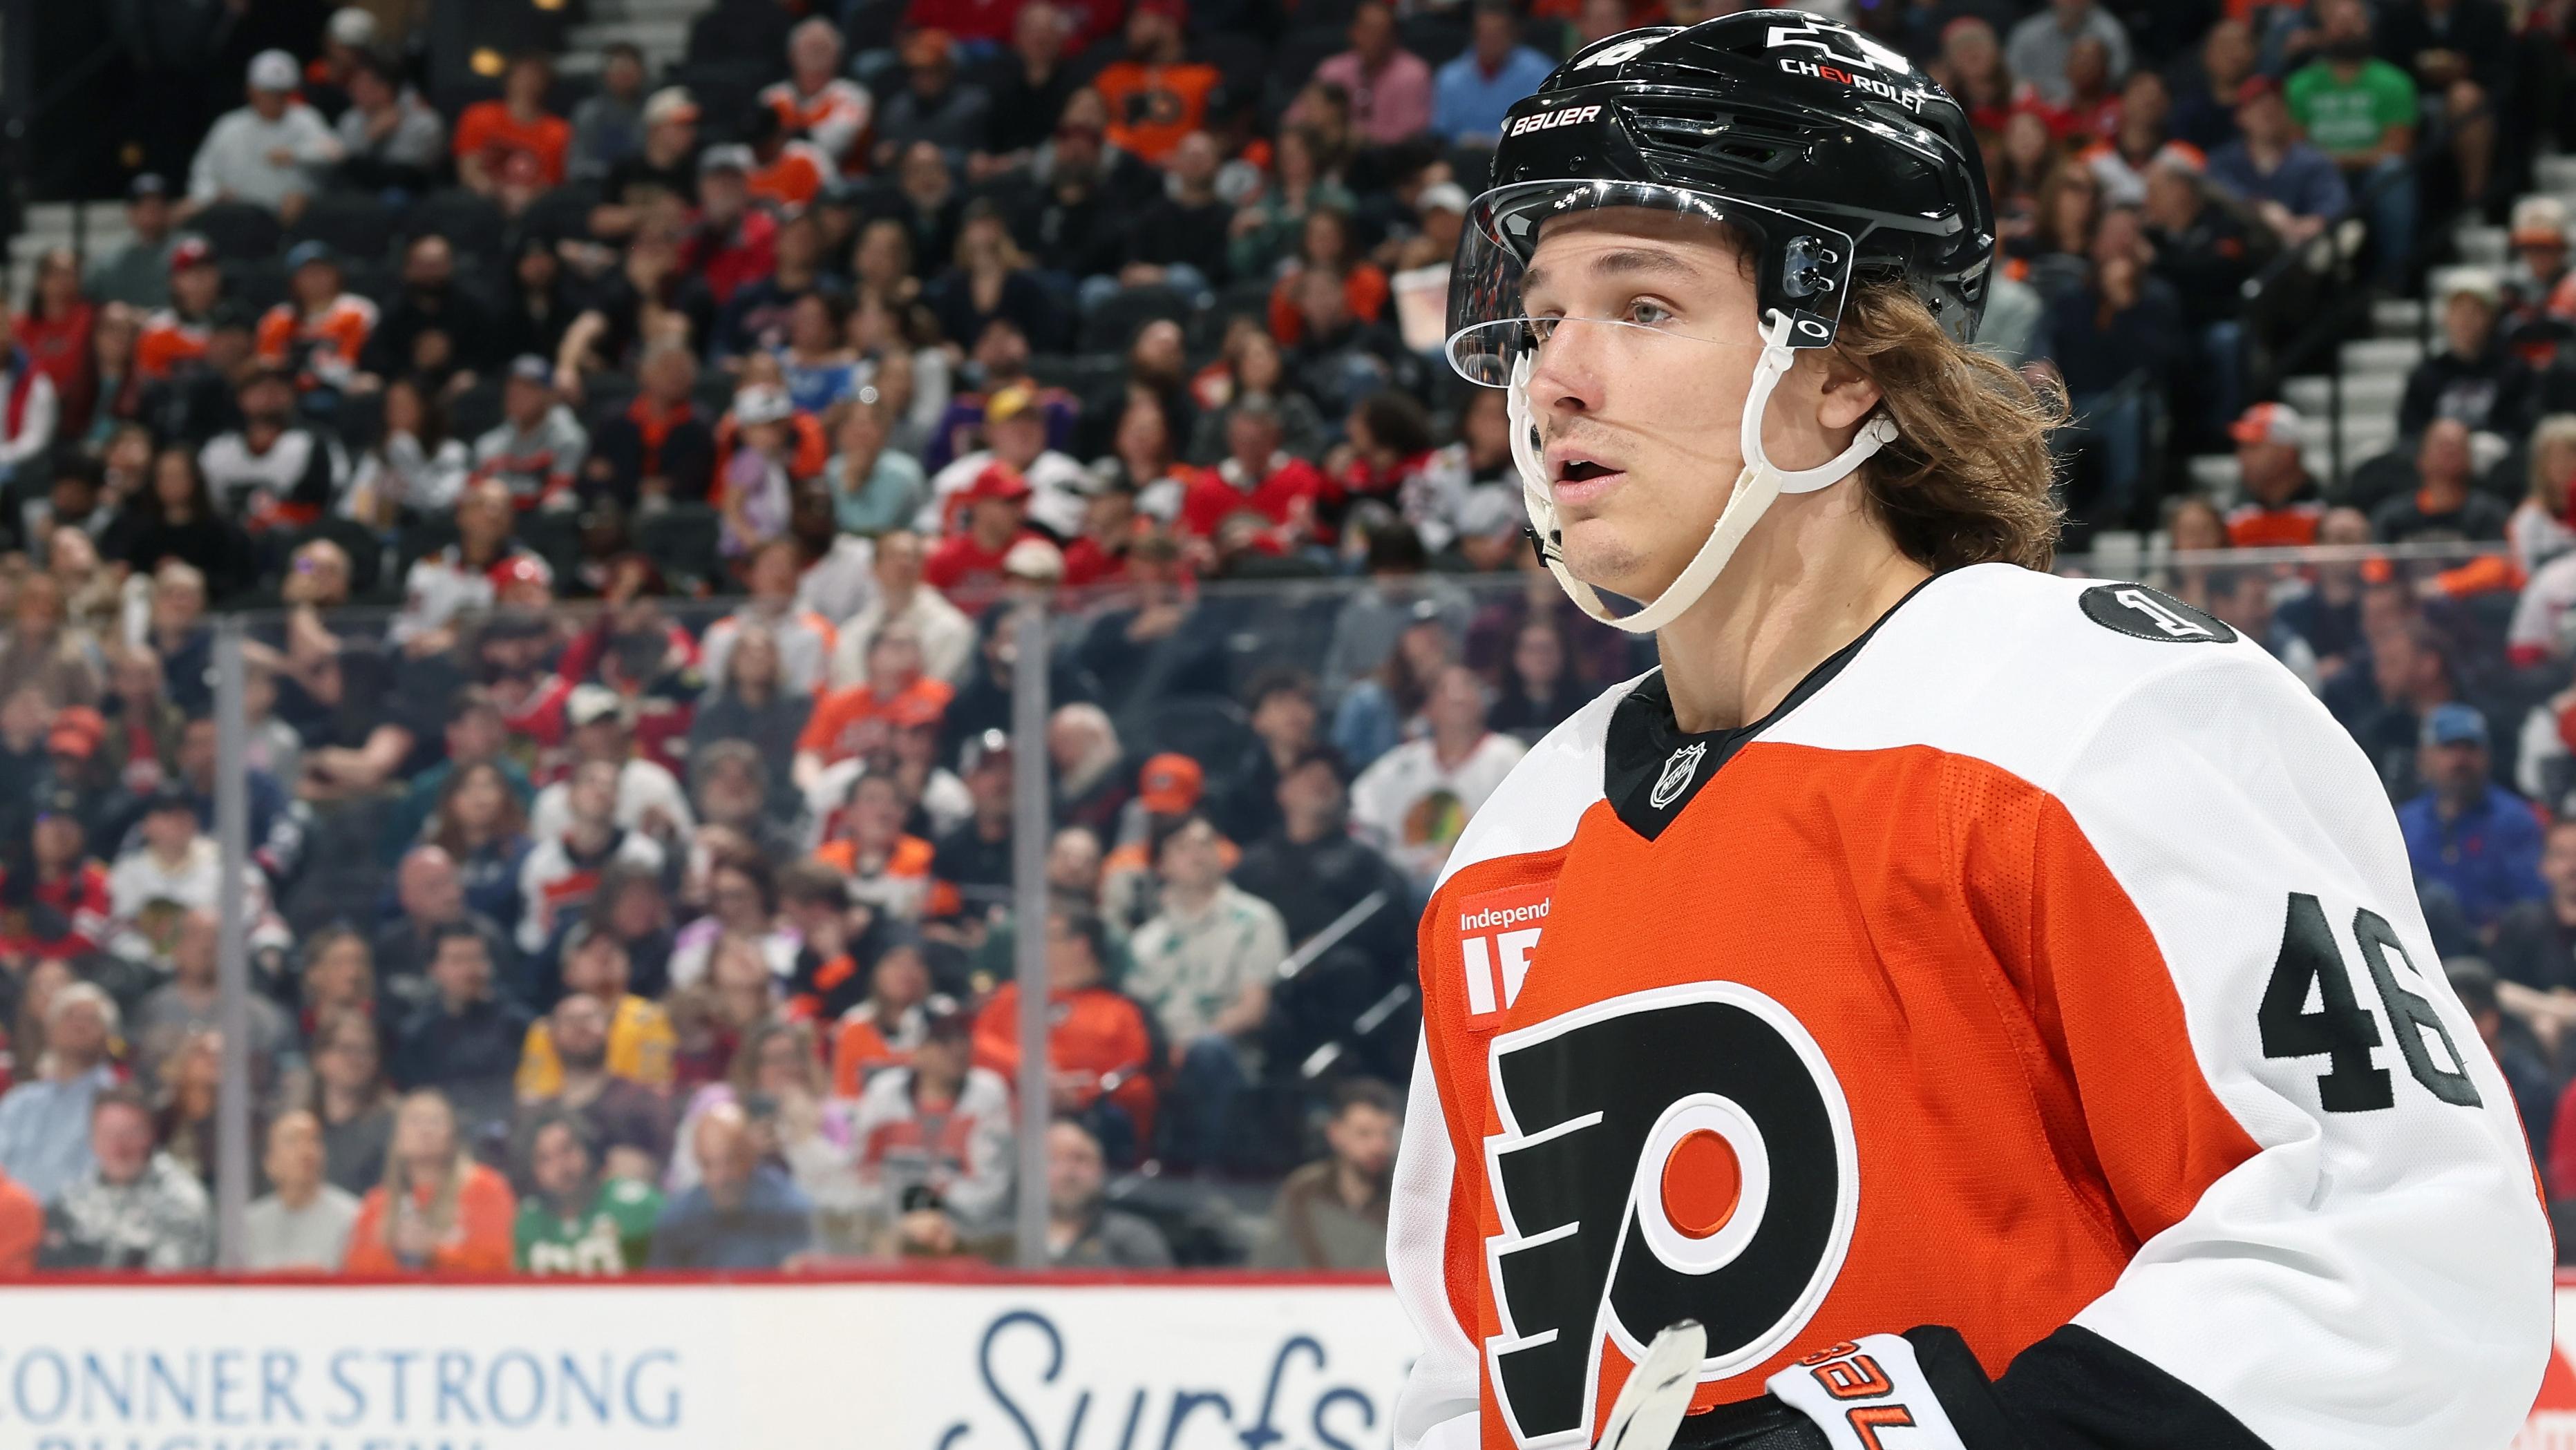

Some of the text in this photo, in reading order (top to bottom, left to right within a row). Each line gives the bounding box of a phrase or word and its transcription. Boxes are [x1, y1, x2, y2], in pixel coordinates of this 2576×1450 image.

[1779, 58, 1926, 115] CHEVROLET
[2114, 589, 2214, 637] 1
[1658, 759, 1693, 797] NHL
[1461, 897, 1551, 931] Independ
[2257, 891, 2484, 1113] 46
[0, 1345, 681, 1429] ONNER STRONG
[940, 1310, 1417, 1450] Surfs
